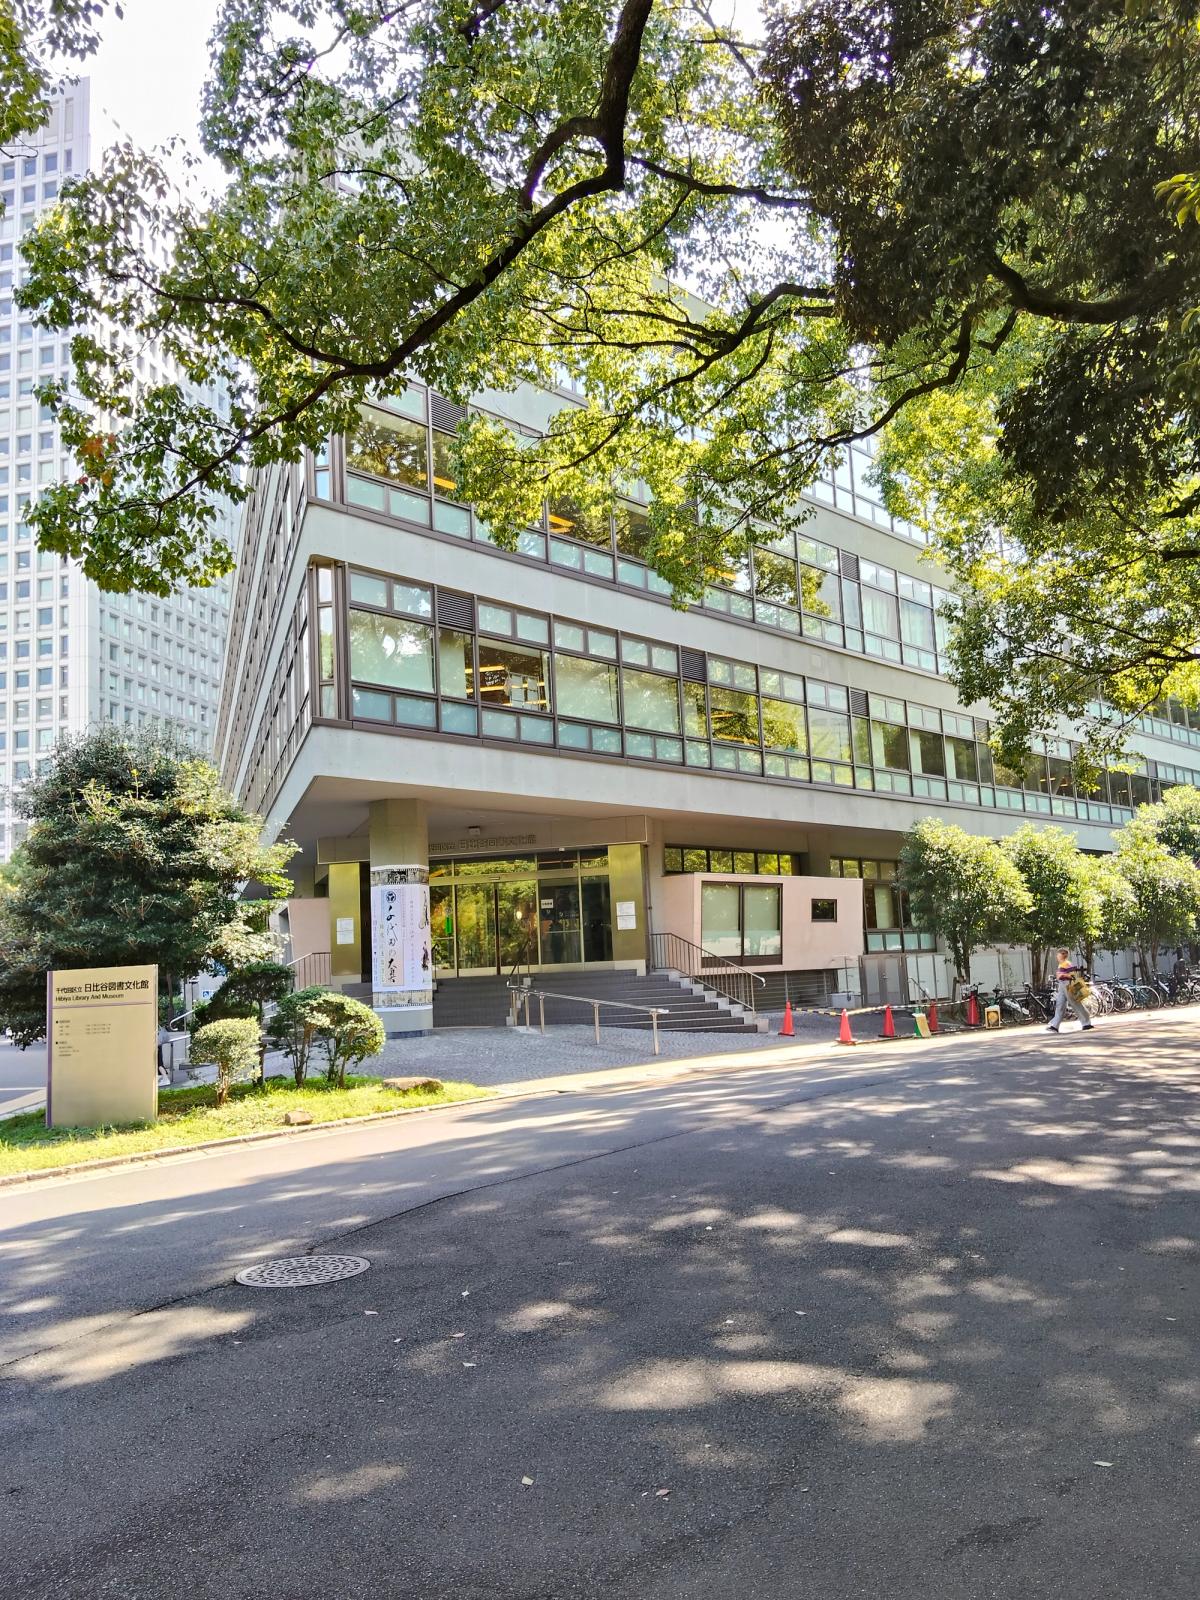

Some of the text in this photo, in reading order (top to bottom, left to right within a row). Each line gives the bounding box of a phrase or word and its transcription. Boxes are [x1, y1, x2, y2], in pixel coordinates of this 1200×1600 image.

[84, 980, 149, 992] 日比谷図書文化館
